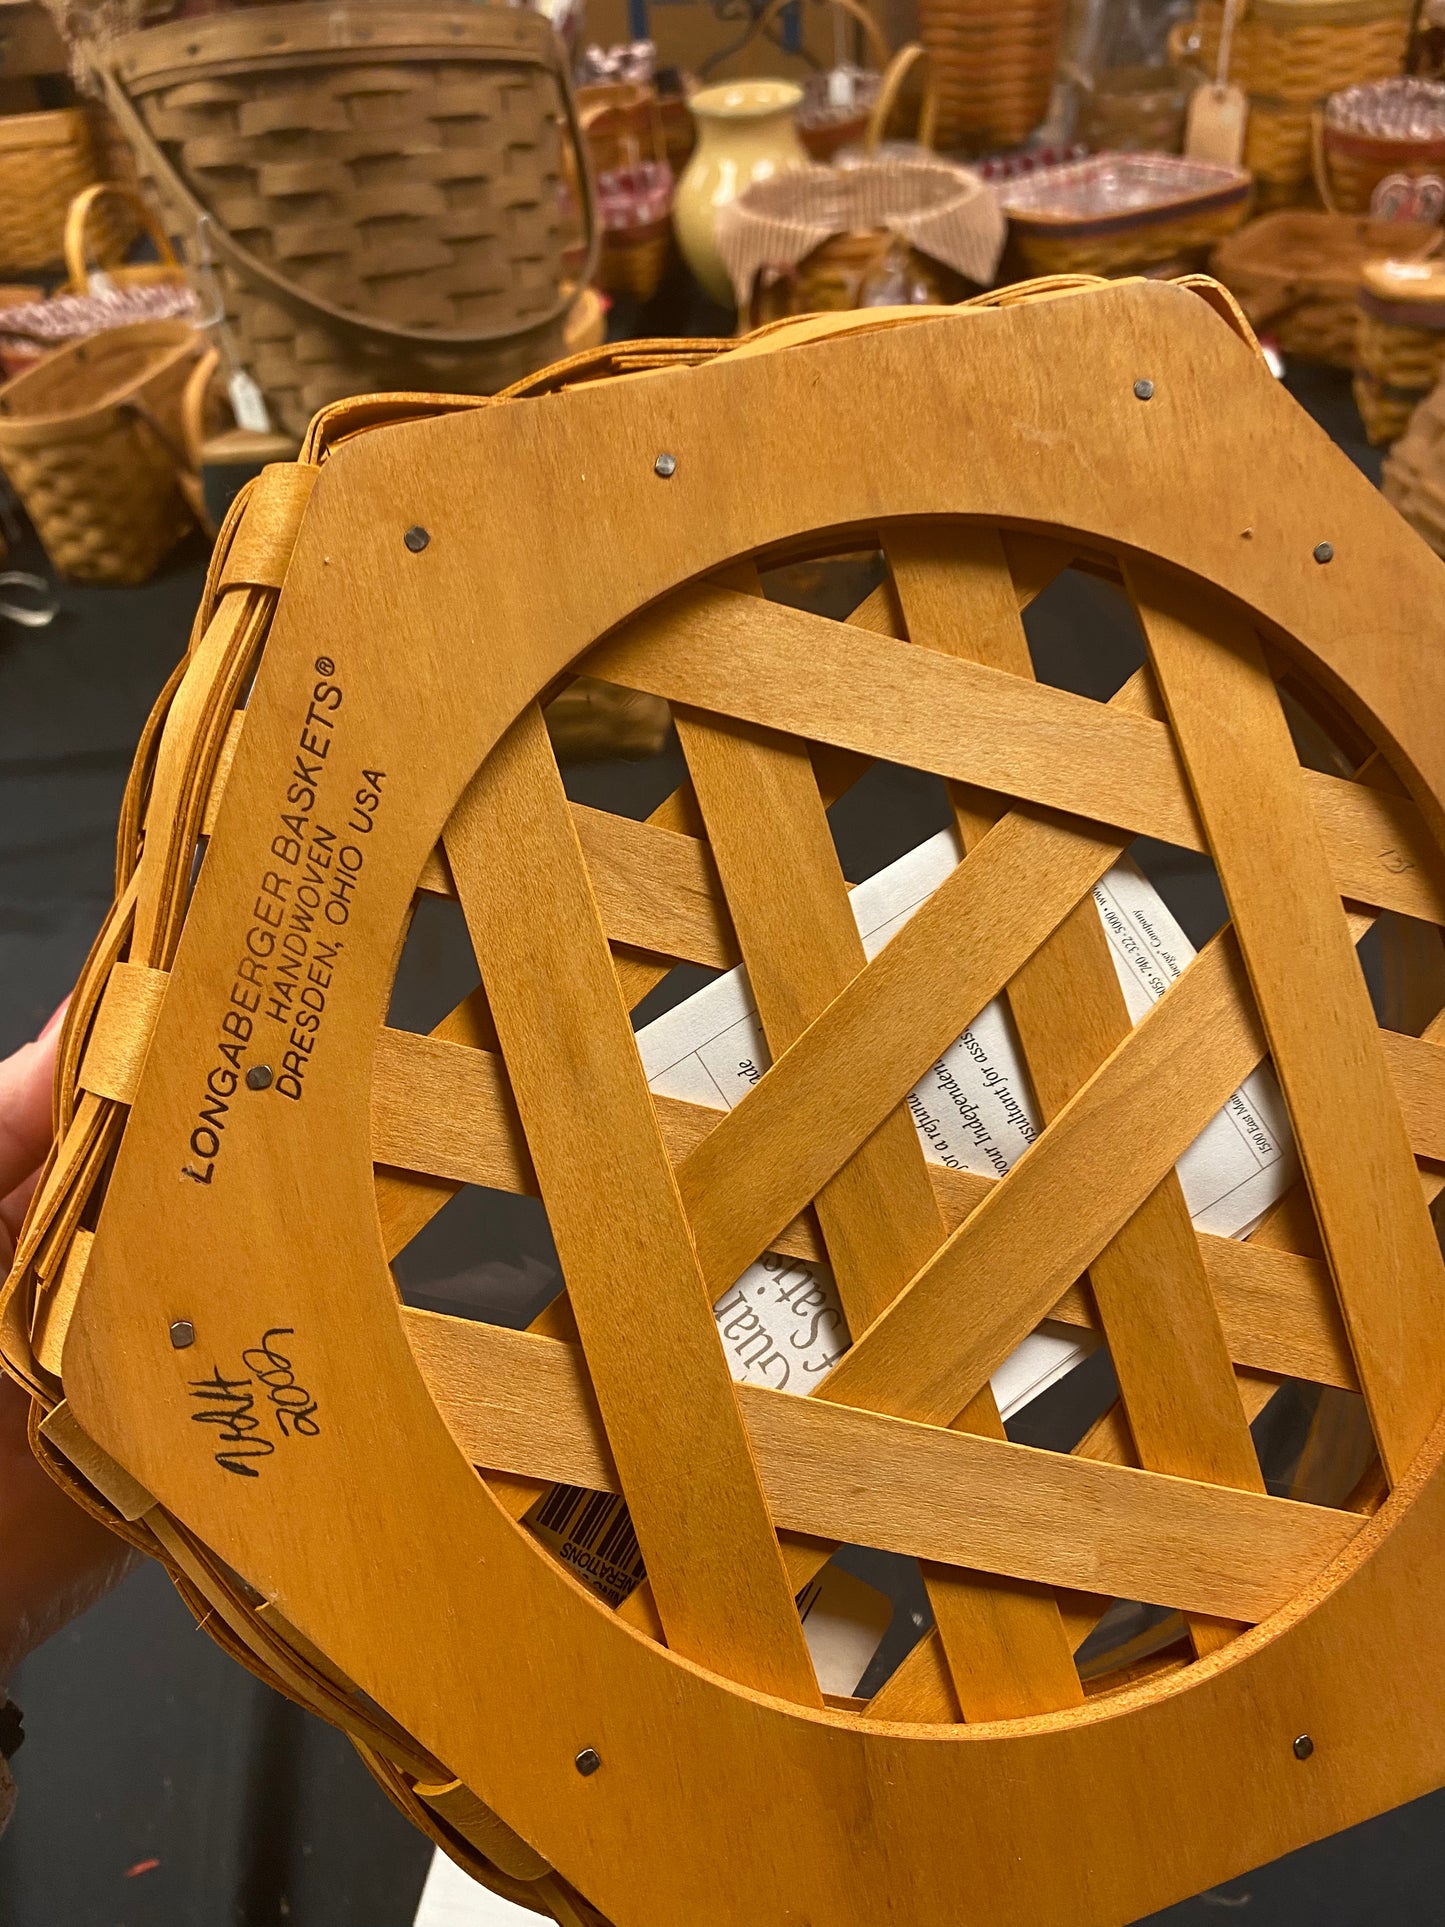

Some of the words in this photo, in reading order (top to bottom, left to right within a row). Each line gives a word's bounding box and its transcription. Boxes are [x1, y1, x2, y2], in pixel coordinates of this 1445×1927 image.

[265, 825, 339, 1024] HANDWOVEN
[275, 941, 344, 1101] DRESDEN,
[325, 844, 364, 926] OHIO
[348, 769, 387, 833] USA
[1133, 910, 1162, 947] Company
[181, 873, 292, 1185] LONGABERGER
[960, 1028, 988, 1062] assis
[981, 1066, 1009, 1087] for
[1242, 1115, 1260, 1133] East
[935, 1140, 948, 1151] a
[1253, 1132, 1274, 1154] 1500
[242, 1328, 320, 1437] 2002
